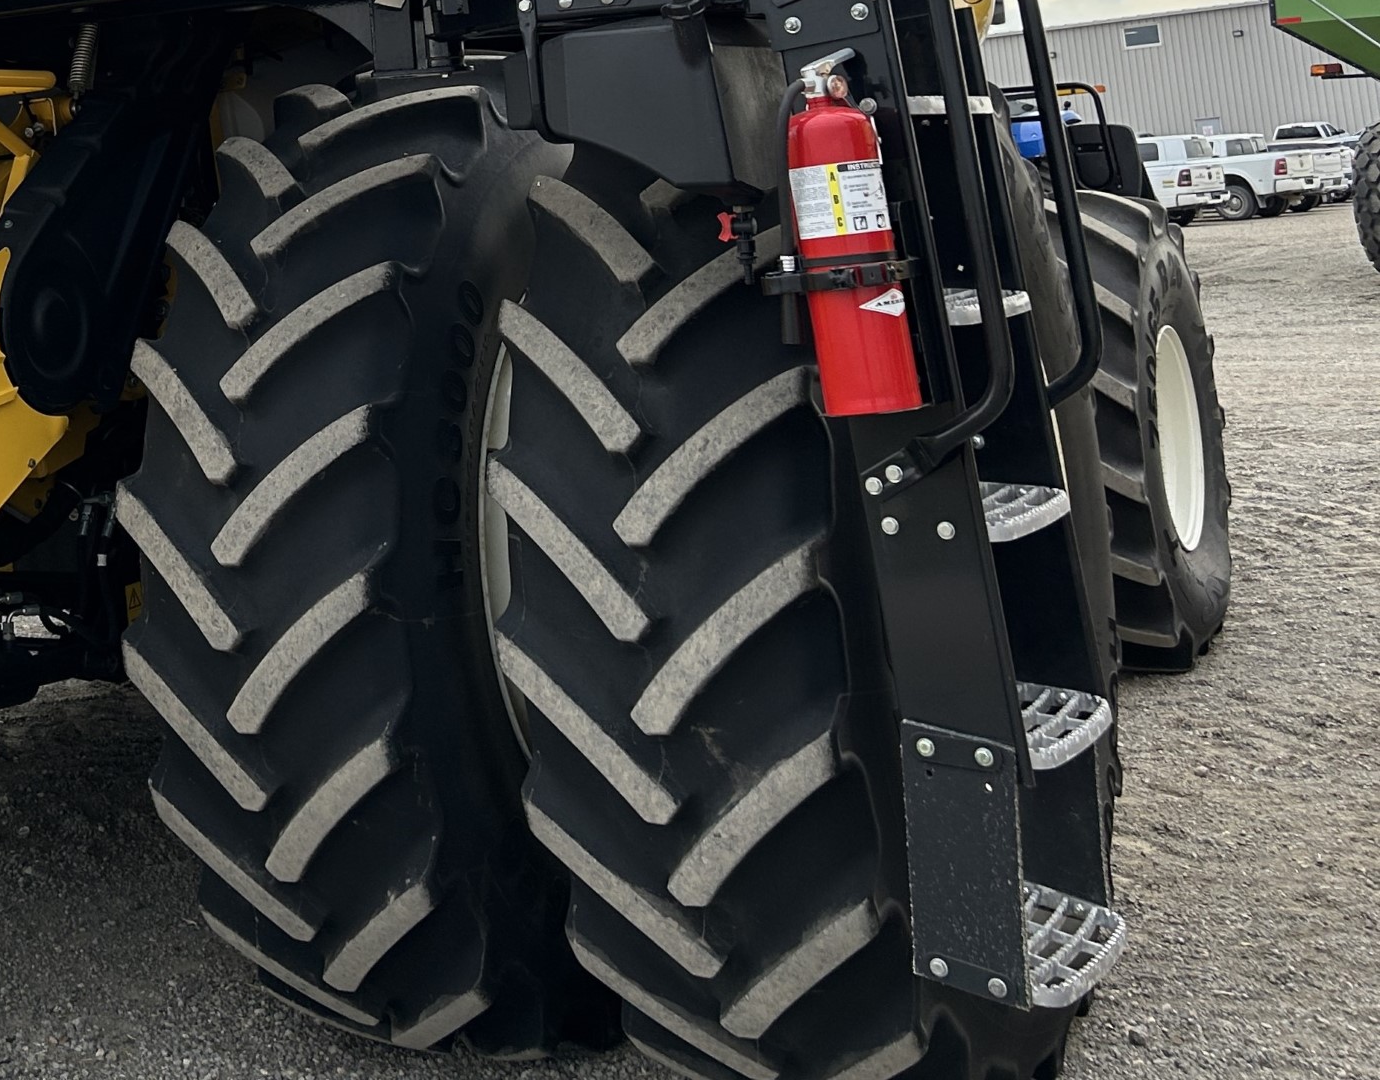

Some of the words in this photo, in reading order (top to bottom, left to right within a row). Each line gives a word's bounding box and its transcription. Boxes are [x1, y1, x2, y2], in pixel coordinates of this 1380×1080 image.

[830, 172, 837, 182] A
[833, 195, 840, 205] B
[837, 217, 844, 228] C
